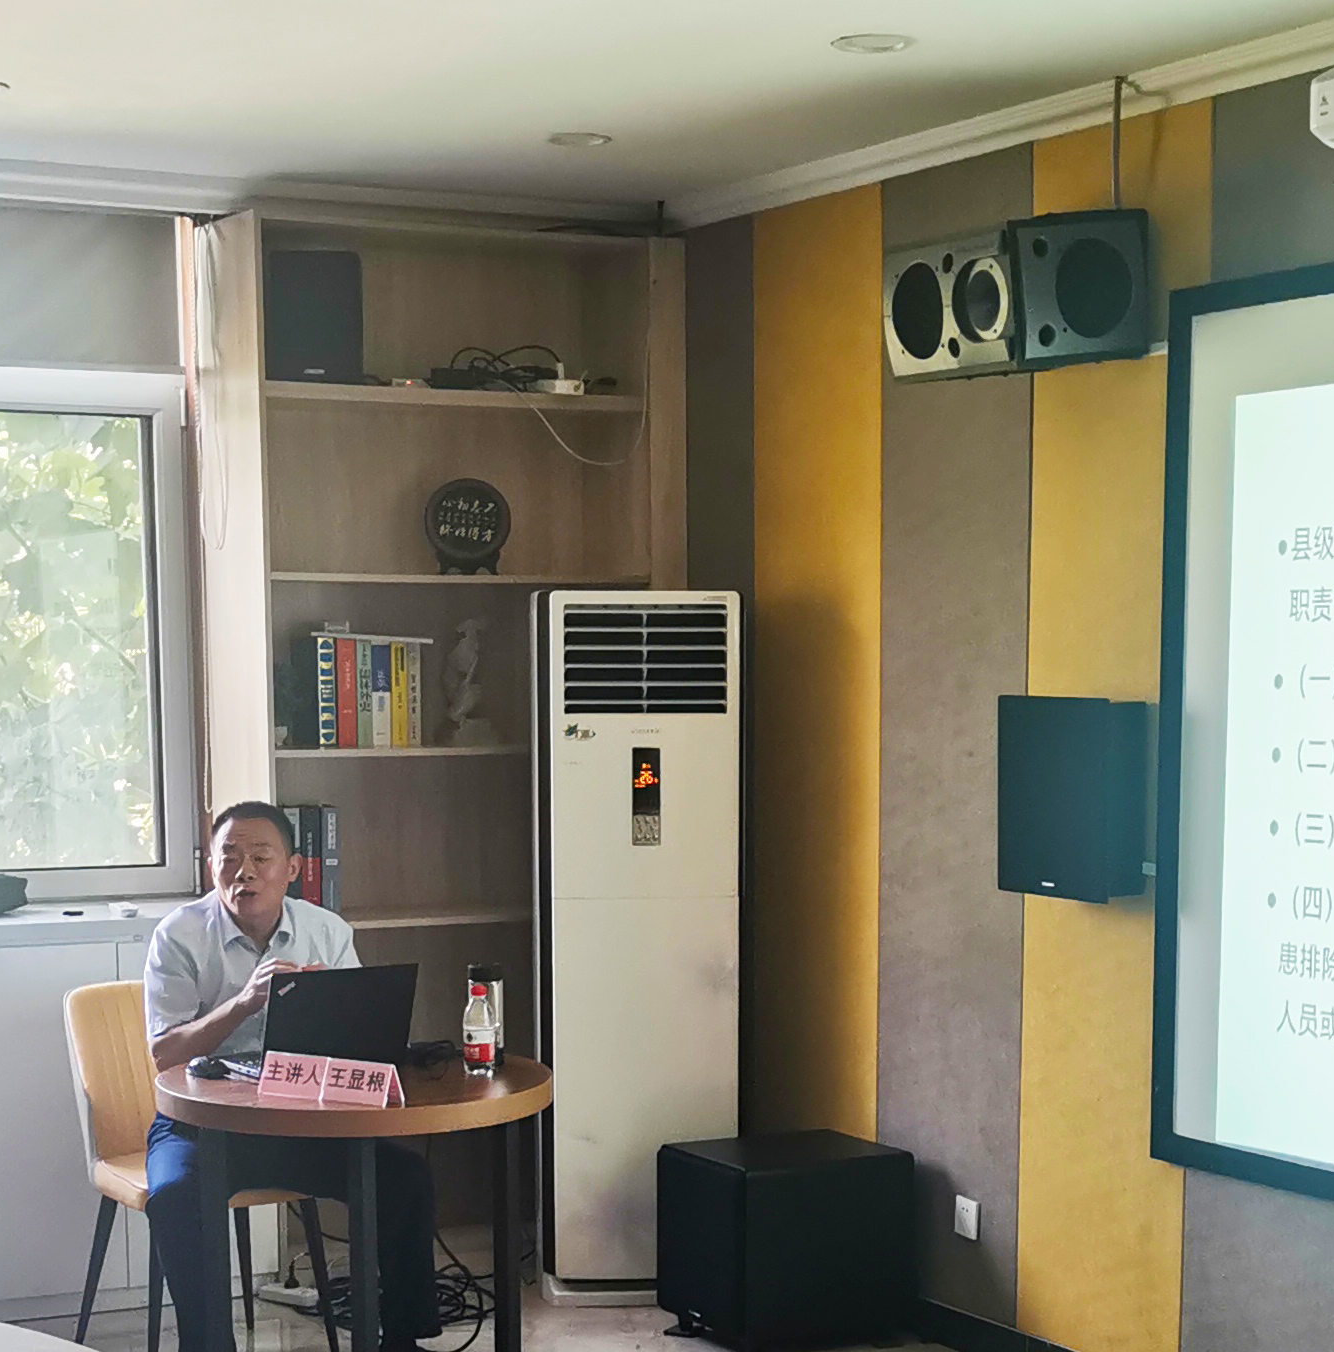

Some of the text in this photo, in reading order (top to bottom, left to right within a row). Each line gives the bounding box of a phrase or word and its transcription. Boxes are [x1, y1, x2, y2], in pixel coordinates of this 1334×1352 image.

[264, 1060, 320, 1086] 主讲人
[328, 1067, 385, 1092] 王显根
